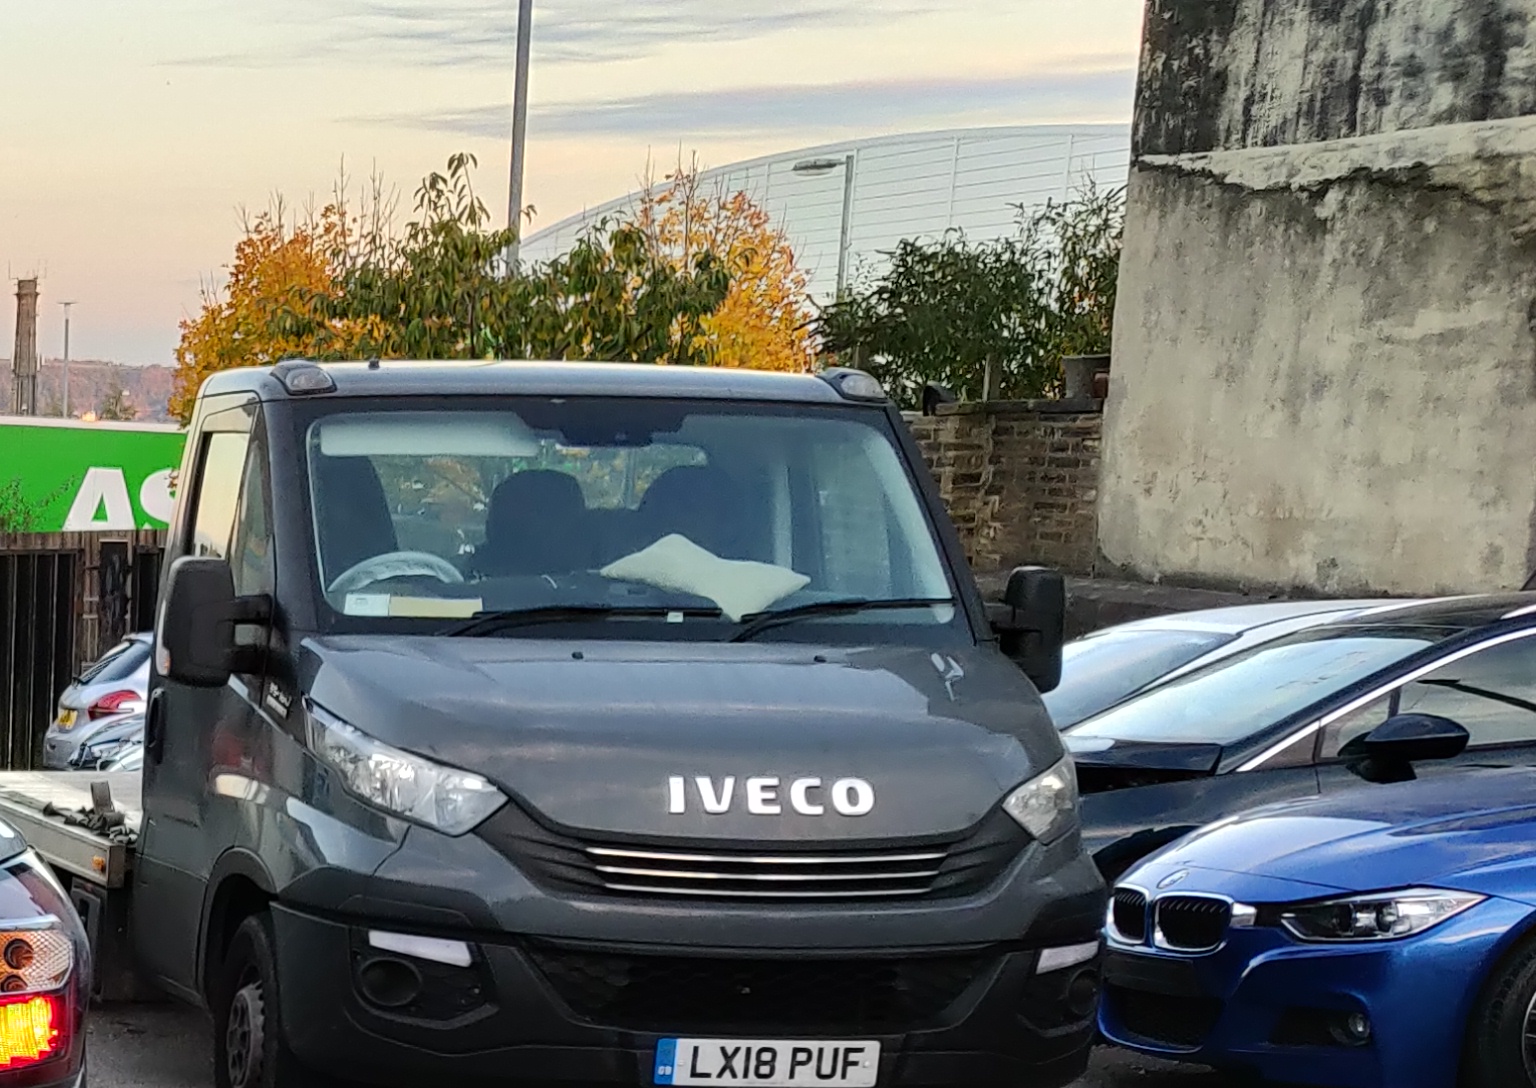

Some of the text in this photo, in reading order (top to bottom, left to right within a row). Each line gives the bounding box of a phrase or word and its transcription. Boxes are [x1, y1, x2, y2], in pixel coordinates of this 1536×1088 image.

[669, 775, 875, 816] IVECO
[690, 1045, 866, 1080] LX18 PUF
